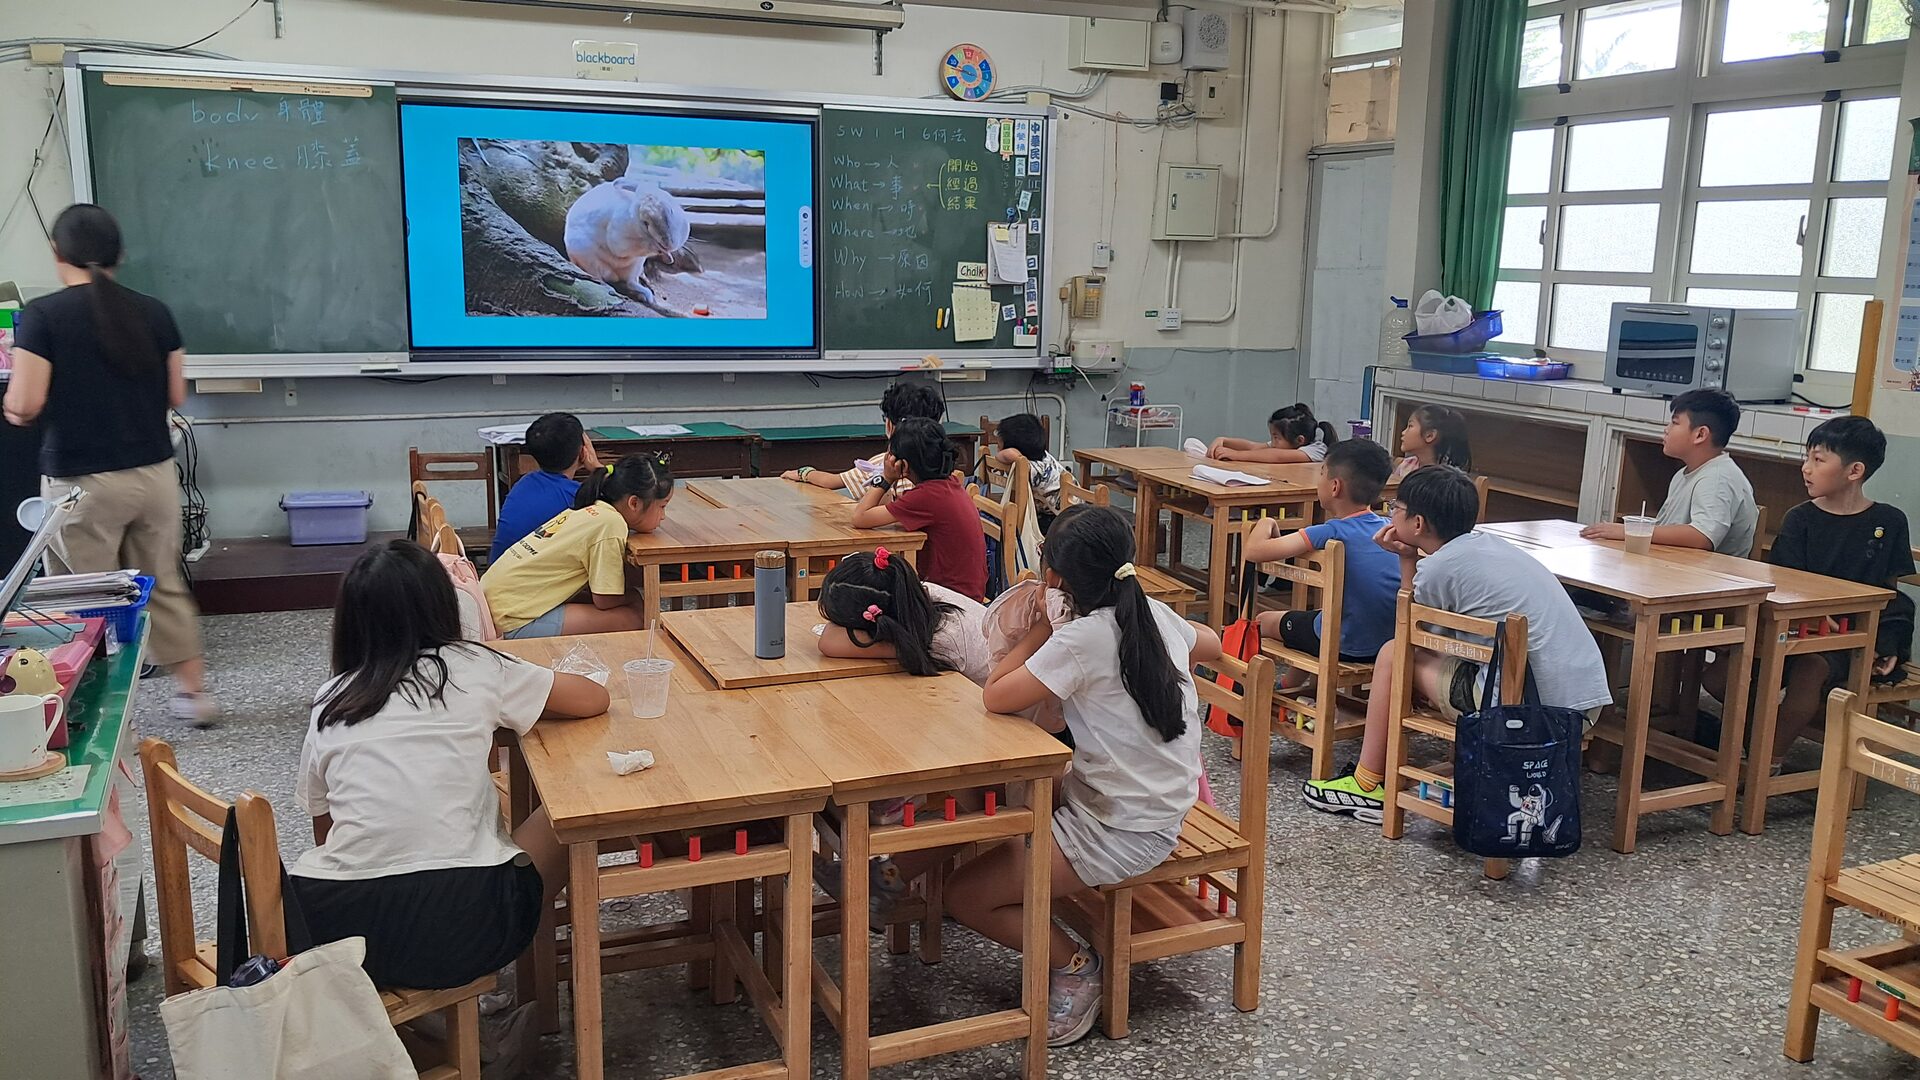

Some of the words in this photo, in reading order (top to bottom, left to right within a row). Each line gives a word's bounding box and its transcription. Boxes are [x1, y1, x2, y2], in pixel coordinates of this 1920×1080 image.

[576, 51, 635, 65] blackboard
[277, 97, 327, 125] 身體
[205, 142, 278, 171] knee
[297, 136, 361, 170] 膝蓋
[1031, 122, 1040, 173] 中華民國
[833, 154, 860, 168] Who
[887, 154, 899, 168] 人
[947, 158, 978, 172] 開始
[831, 173, 868, 192] What
[890, 175, 903, 200] 事
[947, 176, 979, 193] 經過
[831, 196, 871, 211] When
[947, 196, 978, 210] 結果
[831, 220, 874, 237] Where
[1031, 220, 1039, 231] 月
[834, 246, 866, 273] Why
[898, 249, 928, 269] 原因
[1027, 257, 1036, 268] 日
[961, 265, 984, 277] Chalk
[835, 280, 864, 298] How
[1423, 635, 1439, 649] 113
[1522, 759, 1548, 769] SPACE
[1872, 760, 1896, 782] 113
